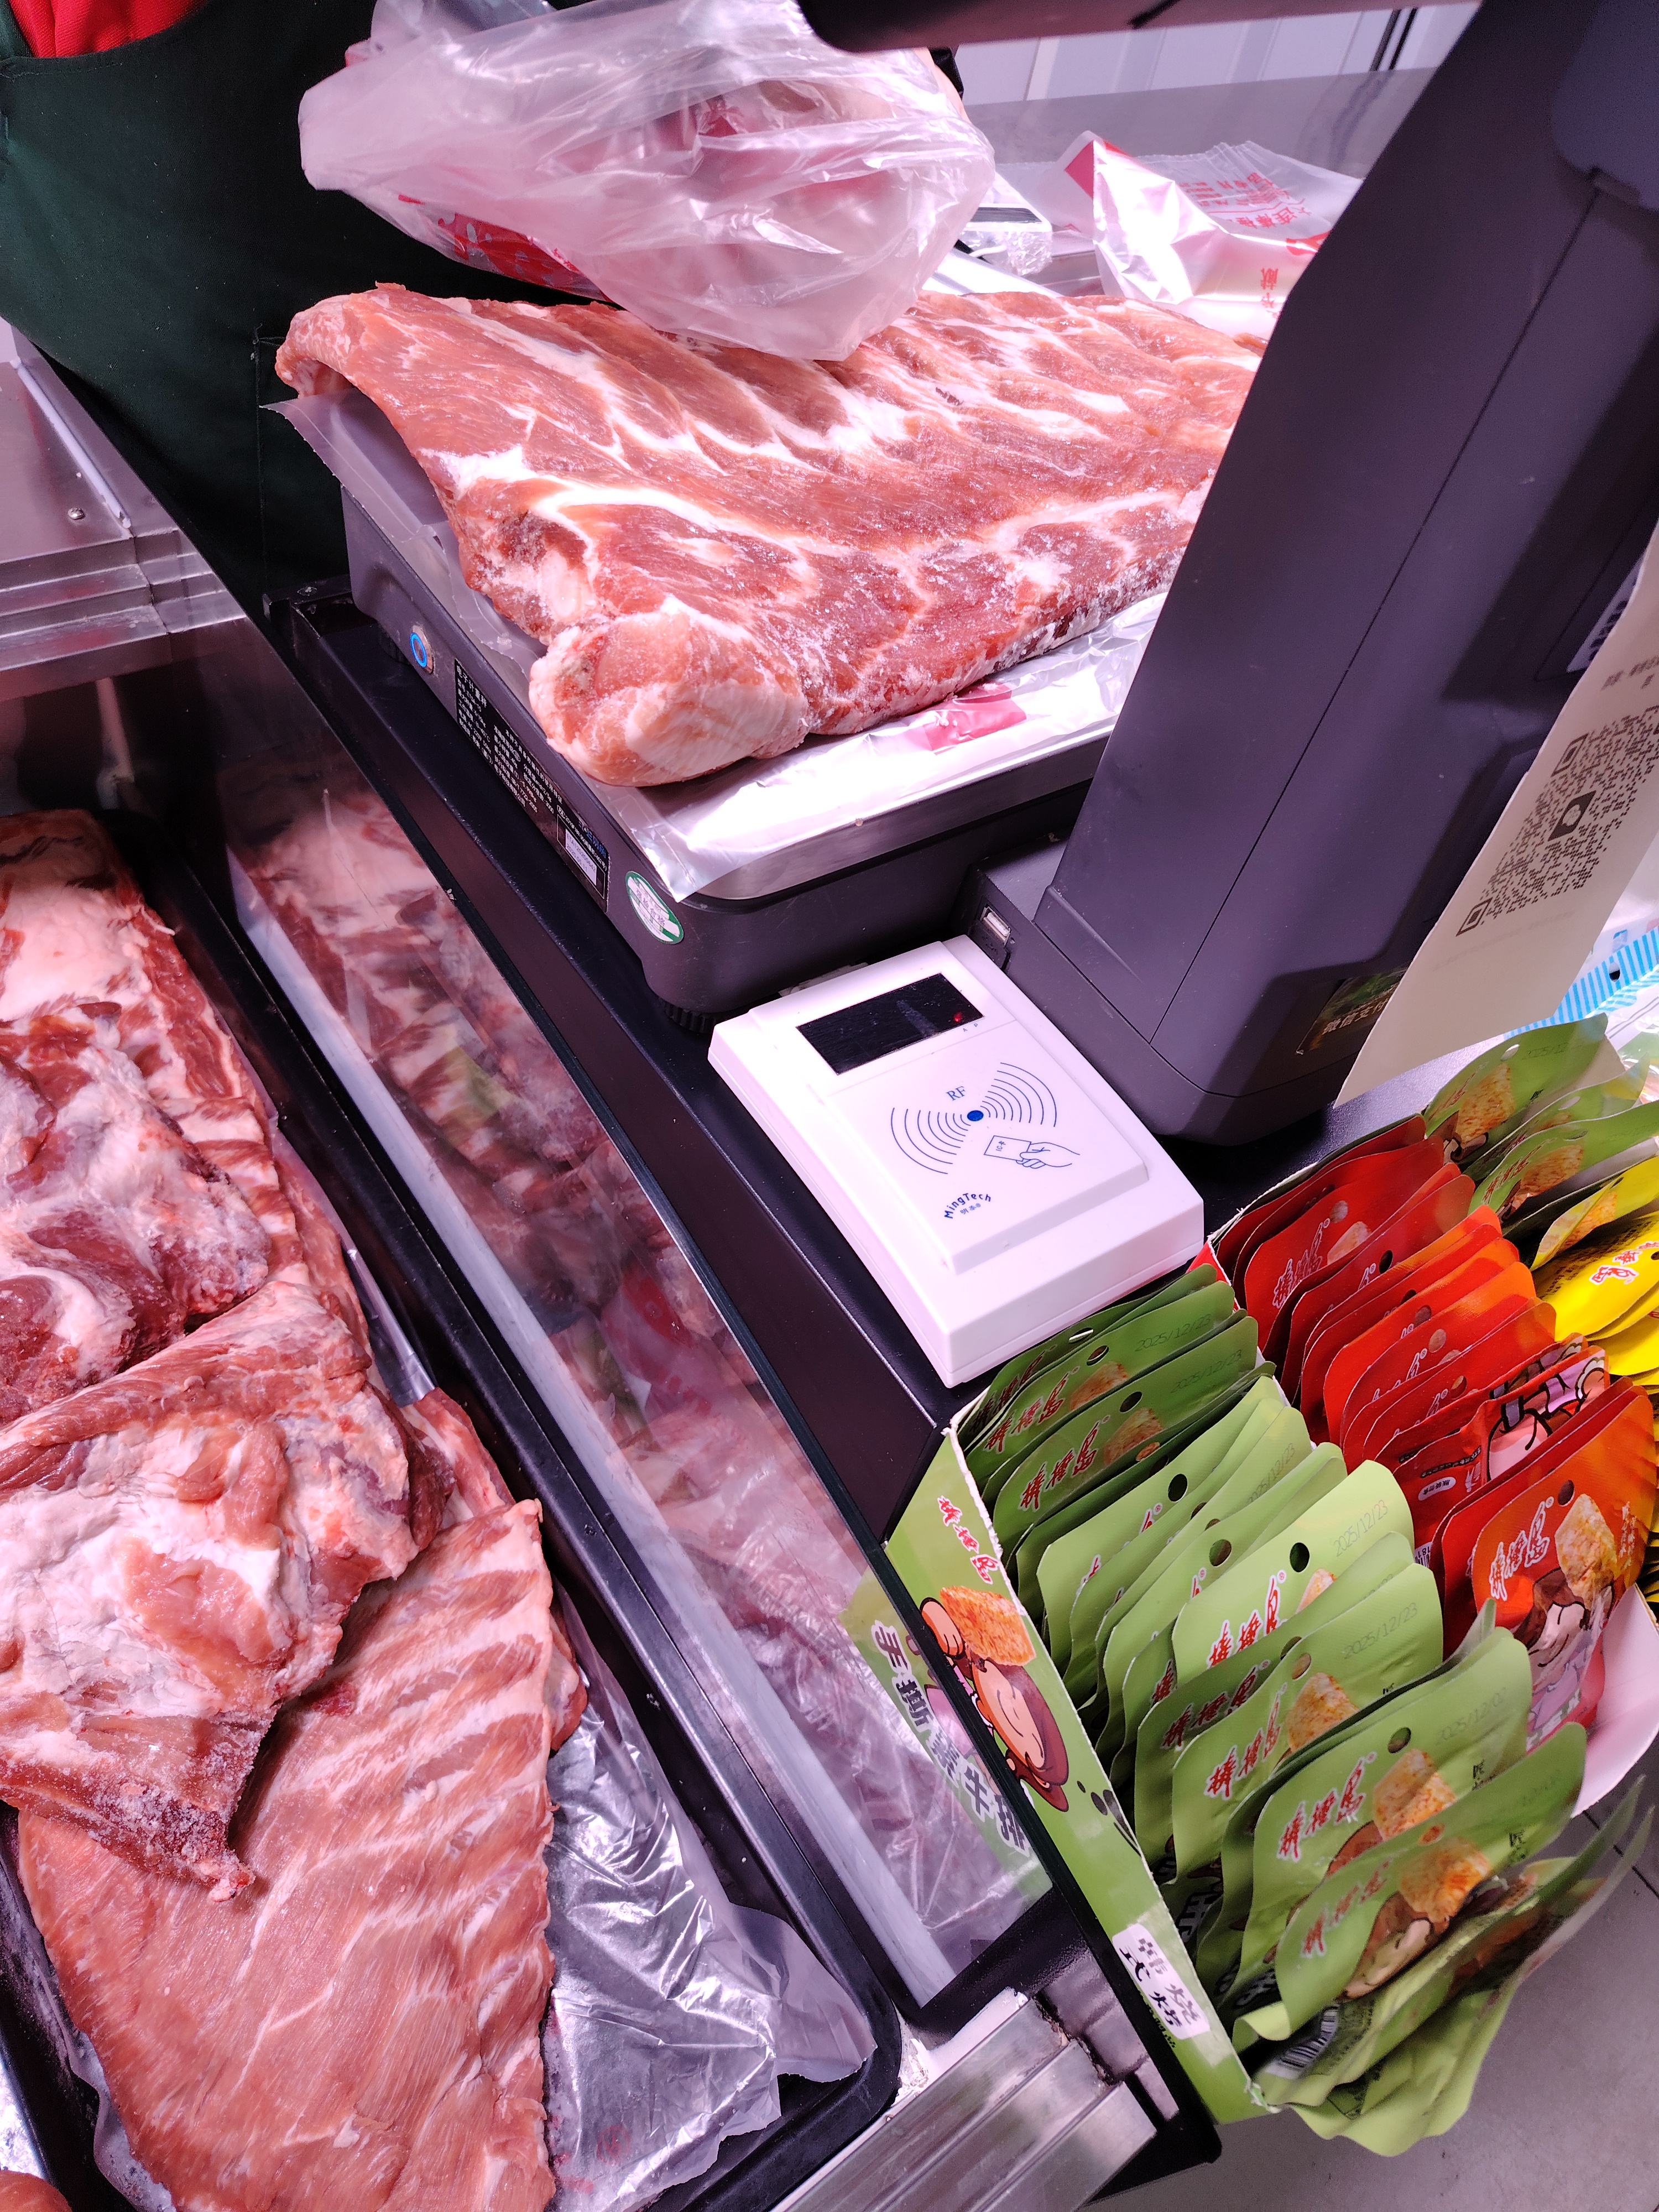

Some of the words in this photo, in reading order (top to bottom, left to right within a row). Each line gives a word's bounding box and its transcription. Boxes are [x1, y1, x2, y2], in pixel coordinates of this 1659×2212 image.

[946, 1086, 966, 1101] RF
[944, 1193, 991, 1219] MingTech
[1134, 1313, 1212, 1352] 2025/12/23
[1333, 1499, 1389, 1558] 2025/12/23
[1344, 1602, 1418, 1660] 2025/12/23
